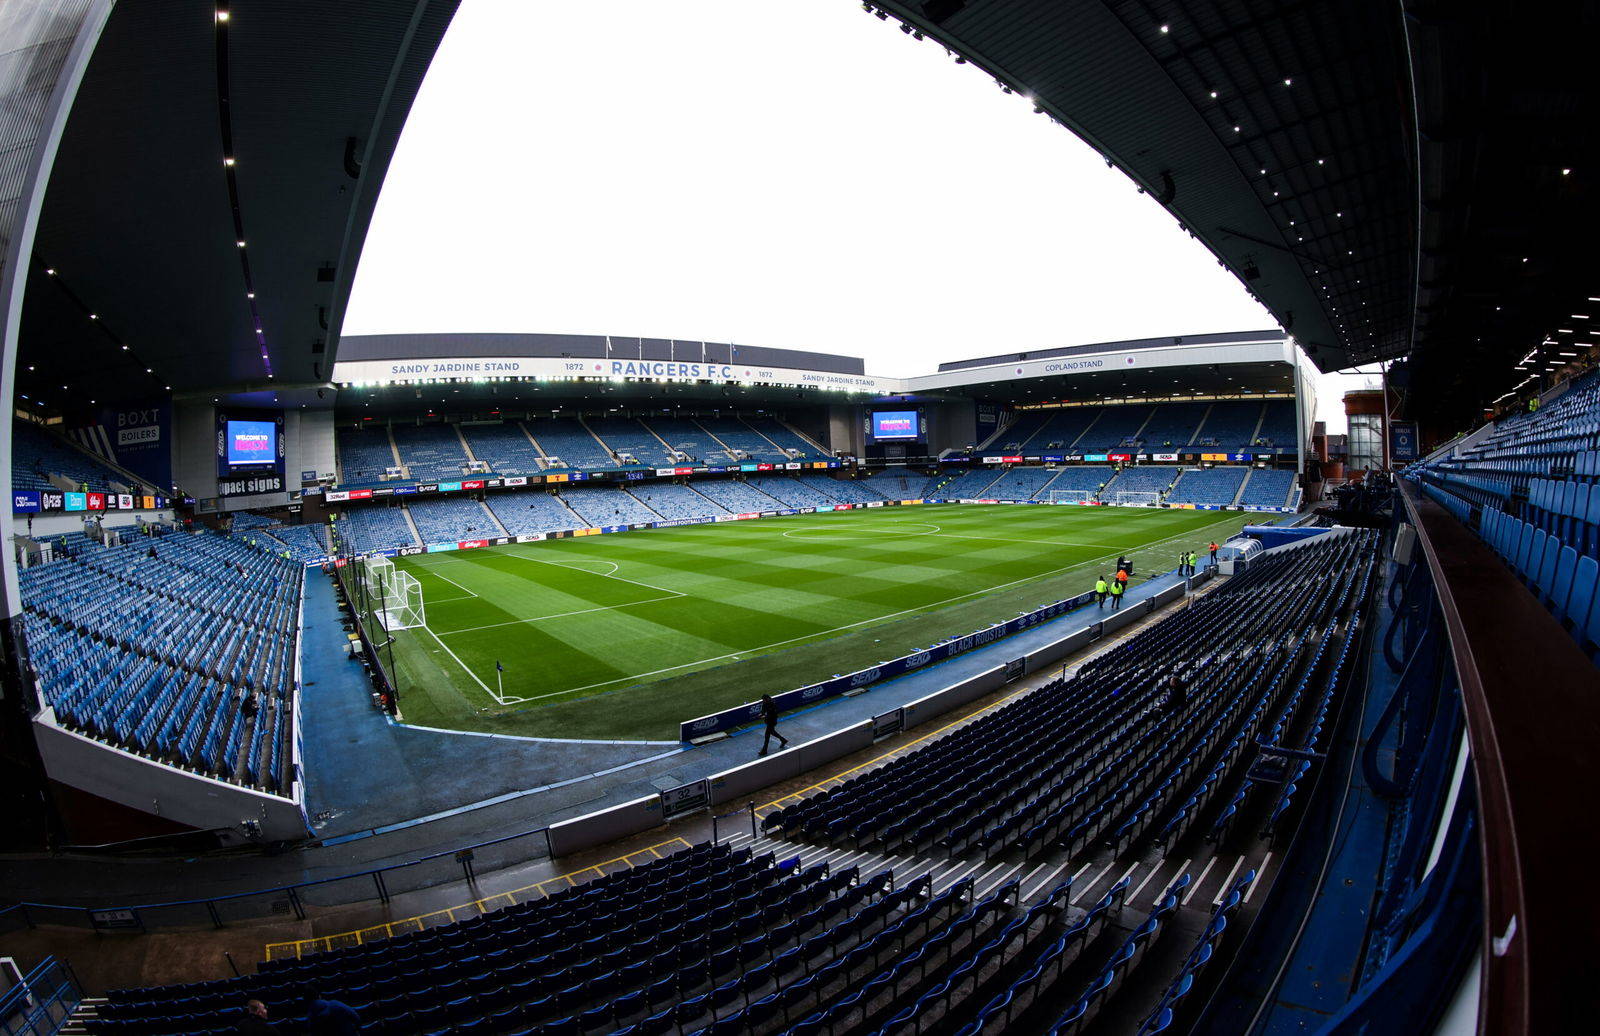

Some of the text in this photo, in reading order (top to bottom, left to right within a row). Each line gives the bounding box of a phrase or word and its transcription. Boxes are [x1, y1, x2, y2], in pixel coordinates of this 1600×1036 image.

[392, 362, 520, 375] SANDY JARDINE STAND
[565, 363, 584, 371] 1872
[611, 361, 737, 379] RANGERS F.C.
[1045, 360, 1103, 372] COPLAND STAND
[802, 374, 875, 386] SANDY JARDINE STAND
[118, 408, 160, 427] BOXT
[121, 429, 157, 442] BOILERS
[248, 478, 281, 492] signs
[656, 520, 678, 528] RANGERS
[678, 518, 701, 526] FOOTBALL
[949, 625, 1007, 656] BLACK ROOSTER
[905, 652, 931, 668] SEKO
[851, 668, 882, 687] SEKO
[802, 685, 824, 699] SEKO
[692, 717, 719, 731] SEKO
[678, 788, 691, 799] 32
